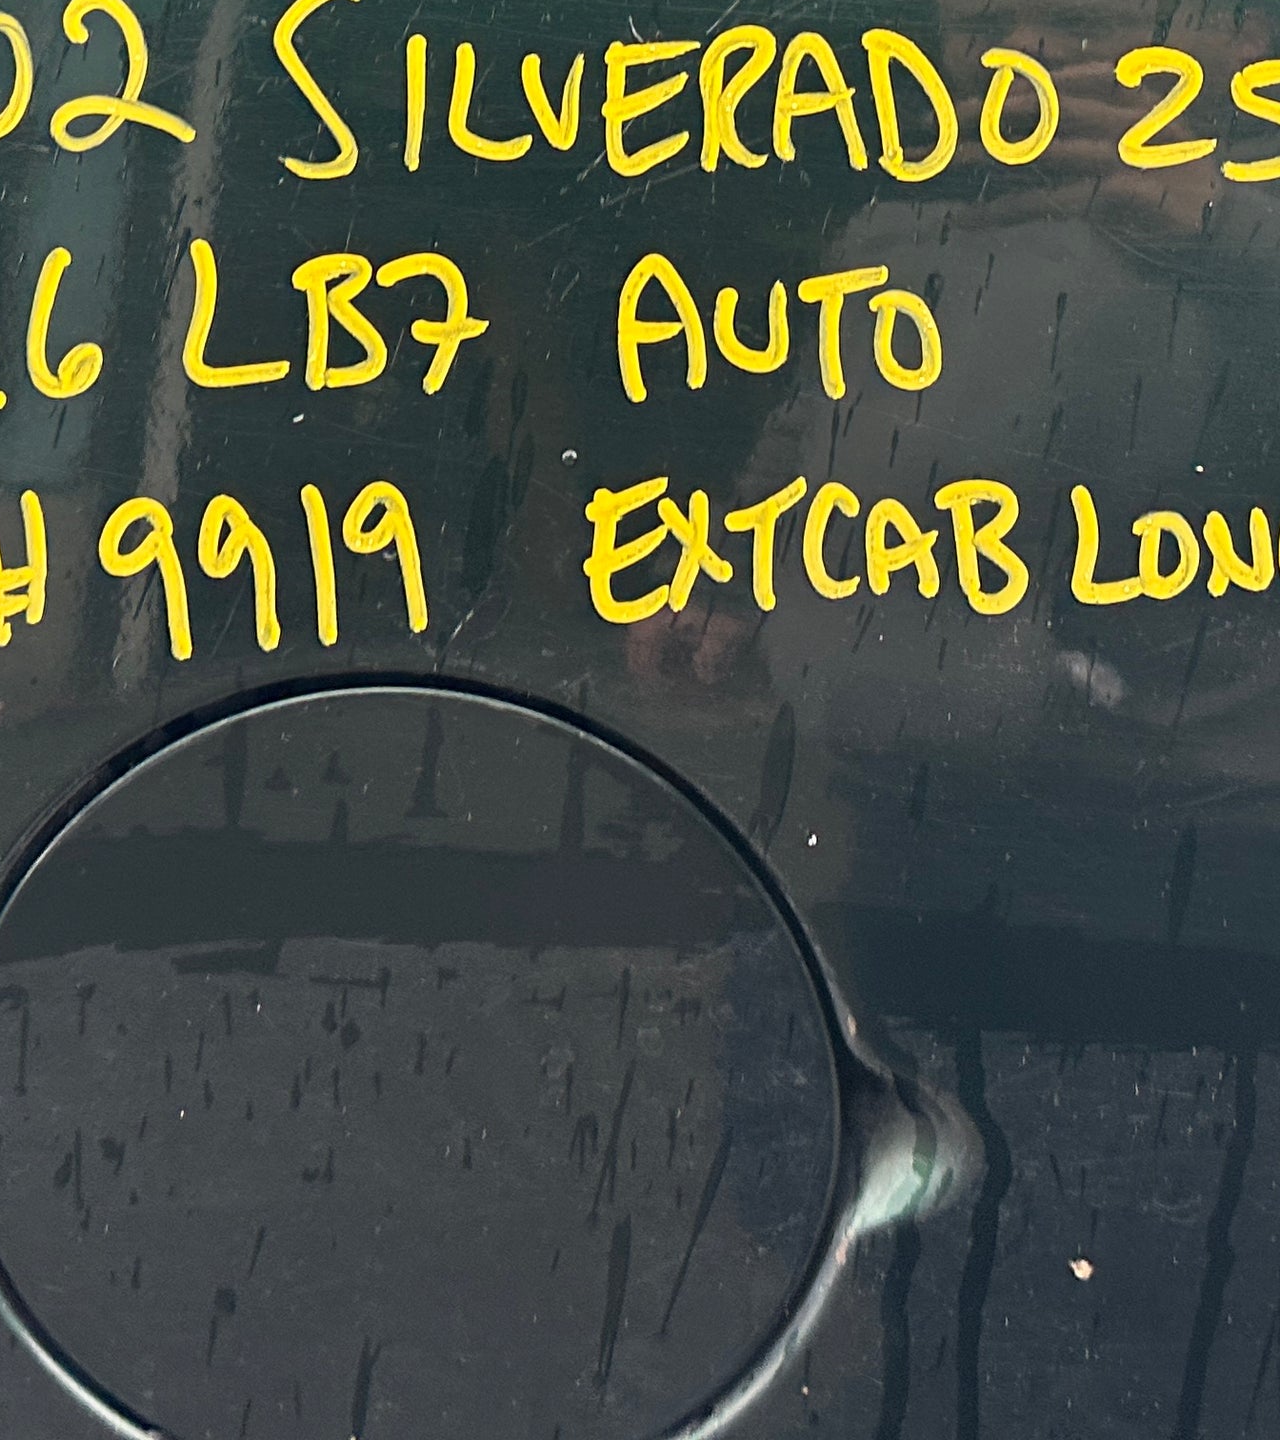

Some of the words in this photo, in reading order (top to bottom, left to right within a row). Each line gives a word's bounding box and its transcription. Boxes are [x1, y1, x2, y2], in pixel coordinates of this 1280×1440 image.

[181, 237, 489, 396] LB7
[616, 252, 944, 404] AUTO
[581, 475, 1031, 625] EXTCAB
